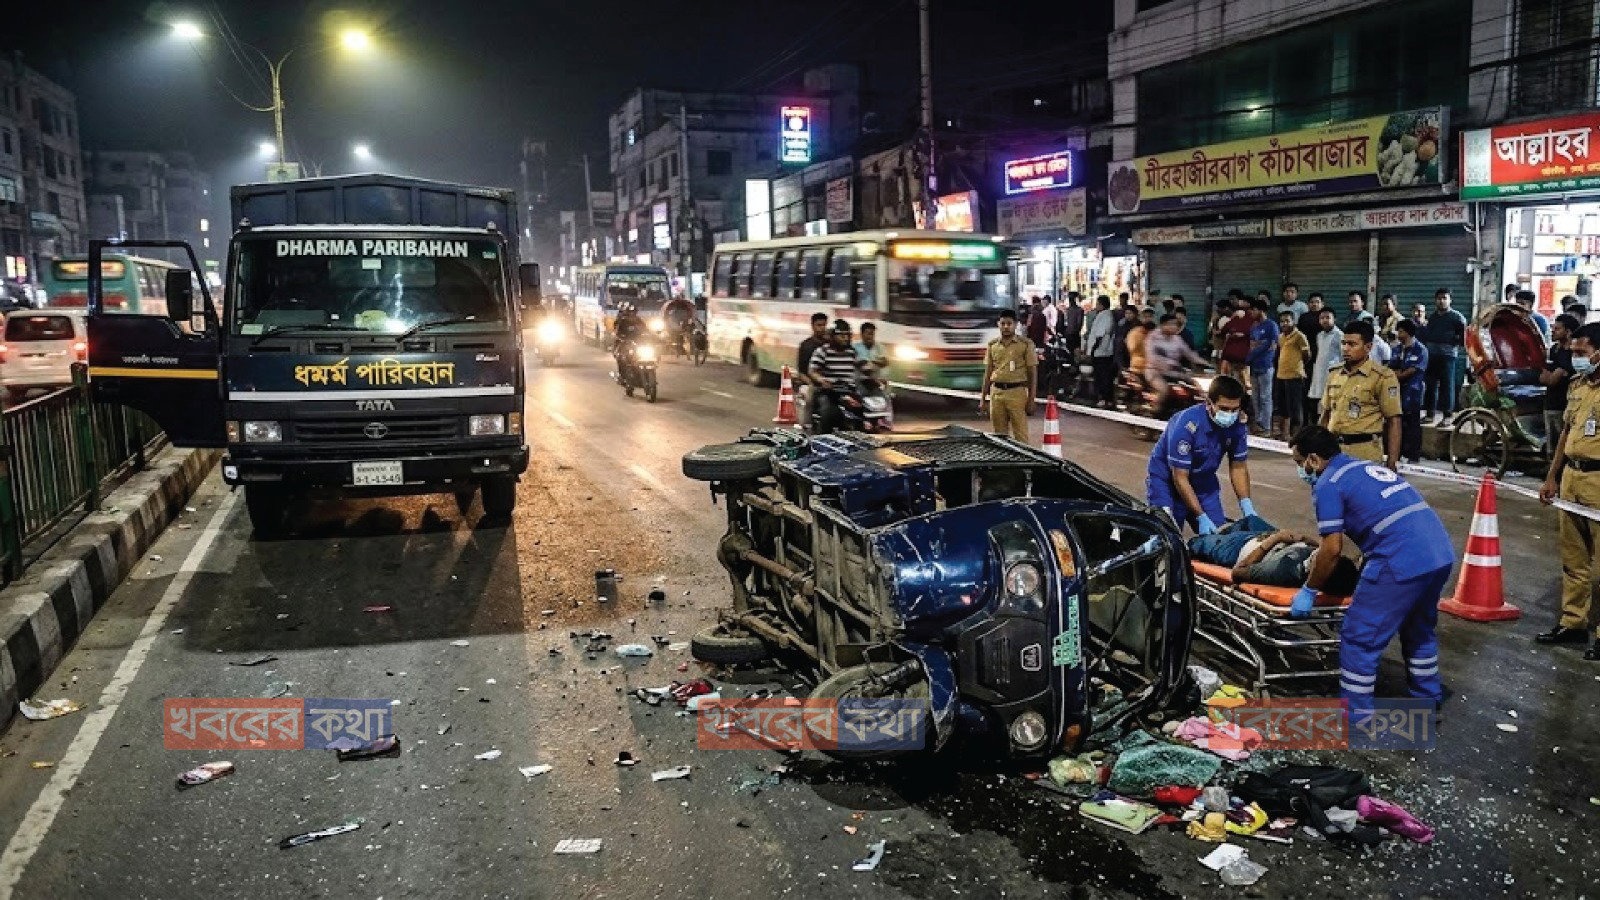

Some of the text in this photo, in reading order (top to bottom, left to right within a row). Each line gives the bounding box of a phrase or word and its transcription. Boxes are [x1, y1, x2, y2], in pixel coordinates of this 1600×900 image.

[1258, 136, 1370, 178] কাঁচাবাজার
[1494, 128, 1592, 167] আল্লাহর
[276, 239, 358, 257] DHARMA
[362, 239, 469, 258] PARIBAHAN
[355, 357, 456, 386] পারিবহান
[355, 400, 396, 411] TATA
